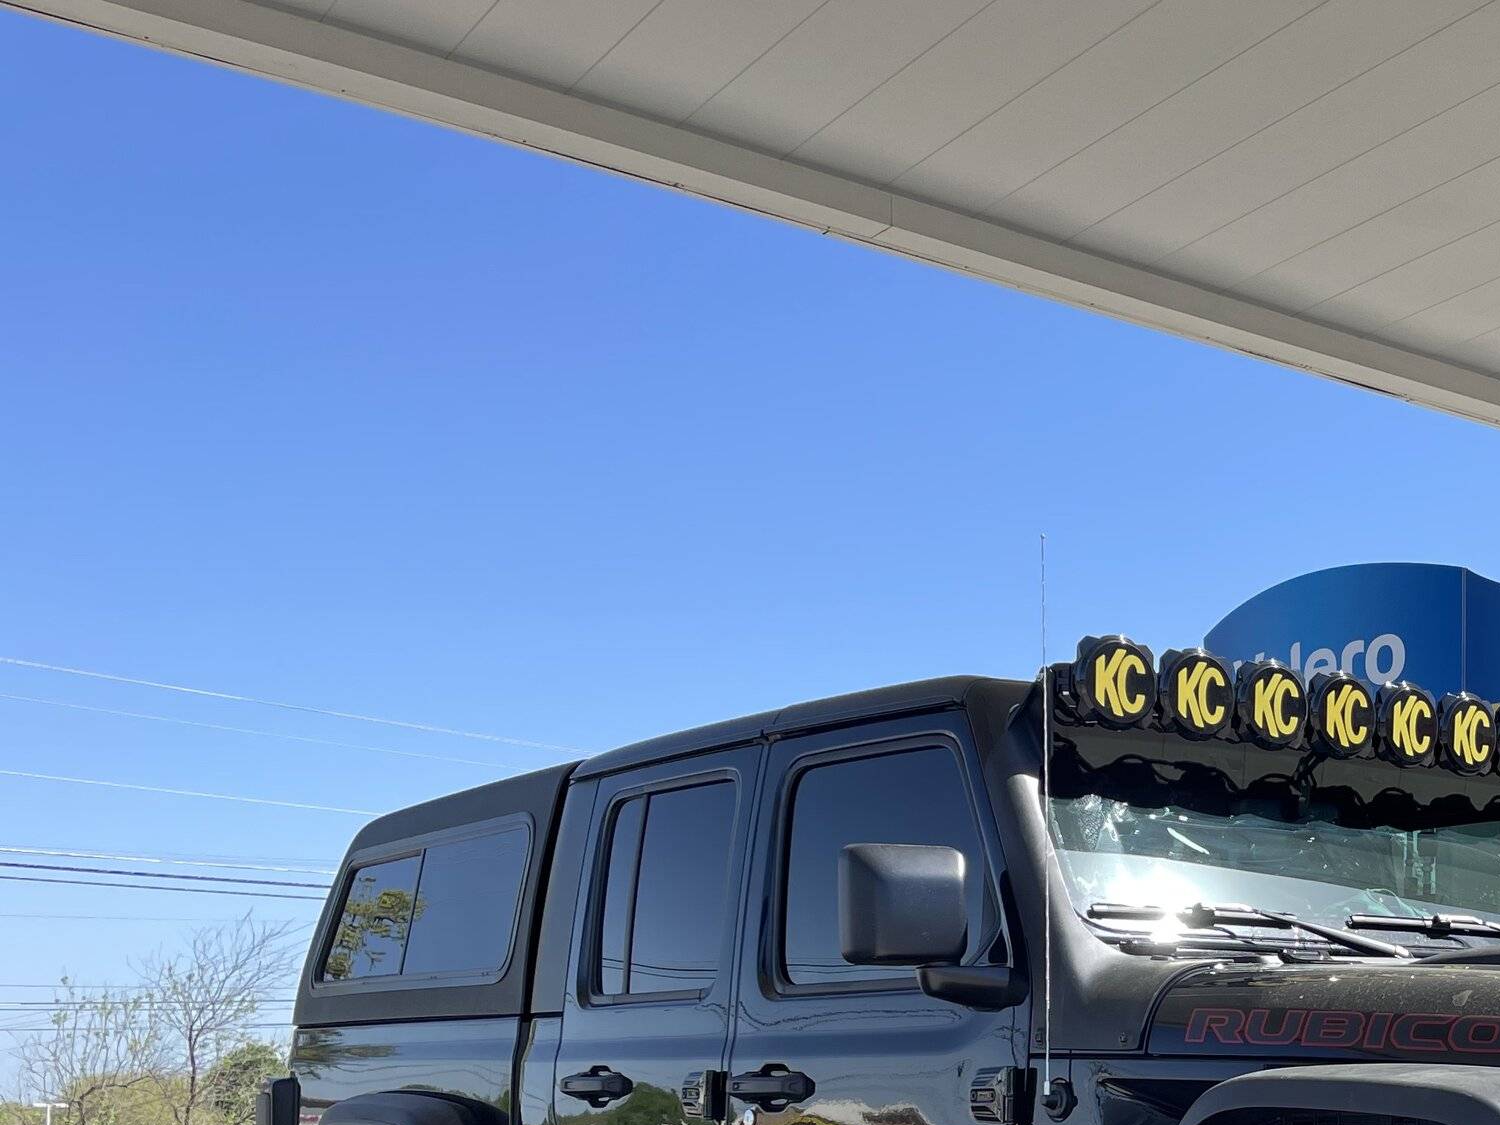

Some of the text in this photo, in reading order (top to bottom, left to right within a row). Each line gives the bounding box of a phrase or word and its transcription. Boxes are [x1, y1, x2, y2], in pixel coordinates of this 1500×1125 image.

[1095, 649, 1146, 717] KC
[1178, 662, 1224, 728] KC
[1254, 673, 1299, 738] KC
[1326, 685, 1368, 747] KC
[1392, 695, 1431, 757] KC
[1453, 705, 1490, 765] KC
